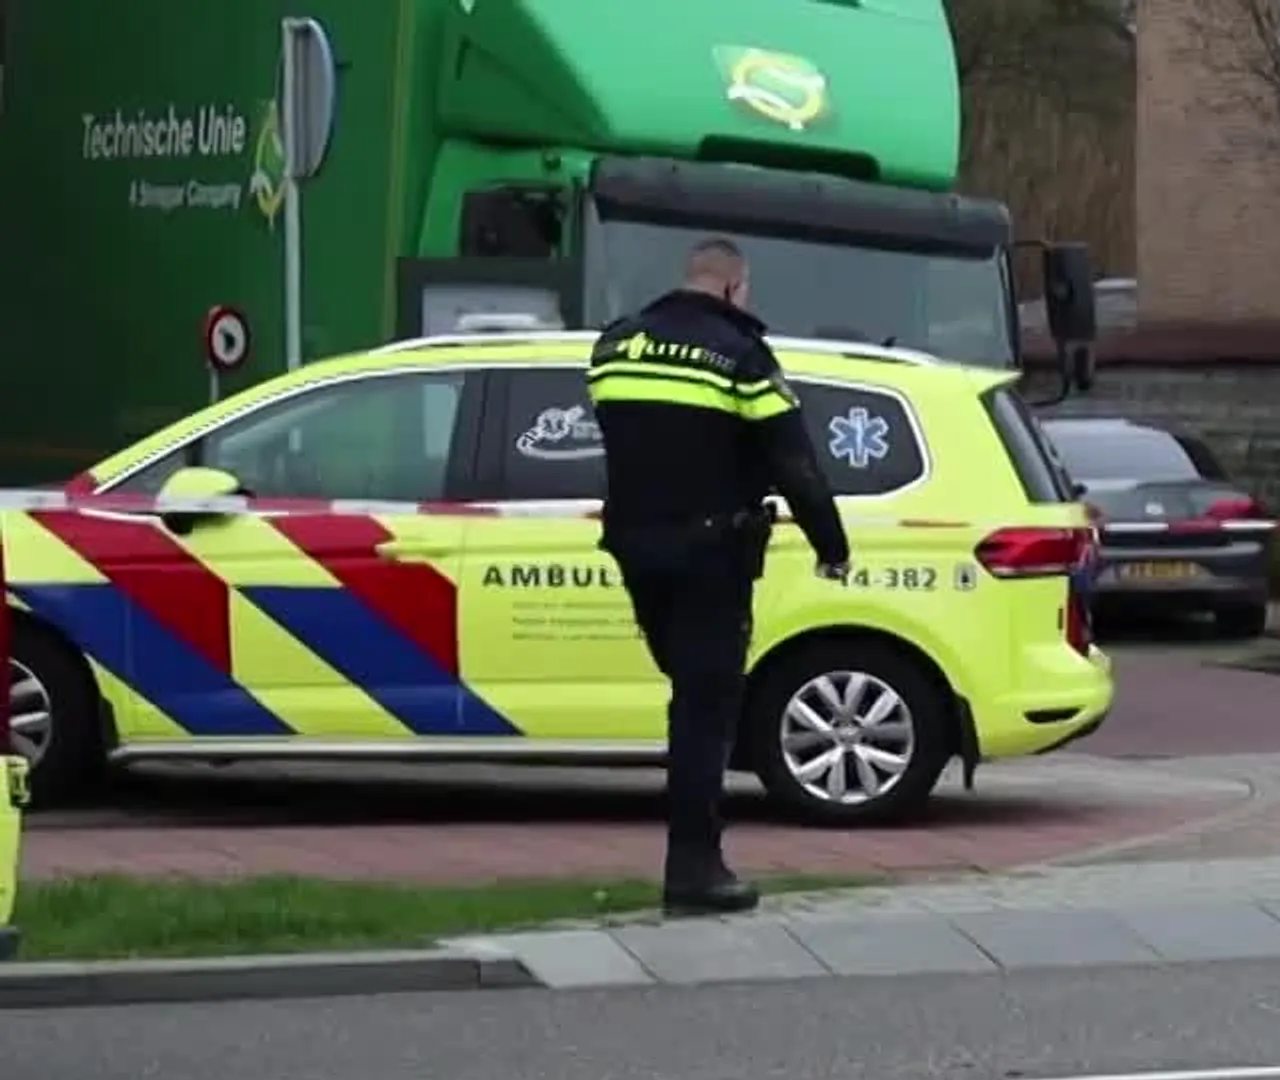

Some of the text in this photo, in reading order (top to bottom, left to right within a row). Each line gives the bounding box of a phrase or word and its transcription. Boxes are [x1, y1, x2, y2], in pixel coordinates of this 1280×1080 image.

[82, 103, 247, 160] Technische Unie
[482, 564, 622, 589] AMBUL
